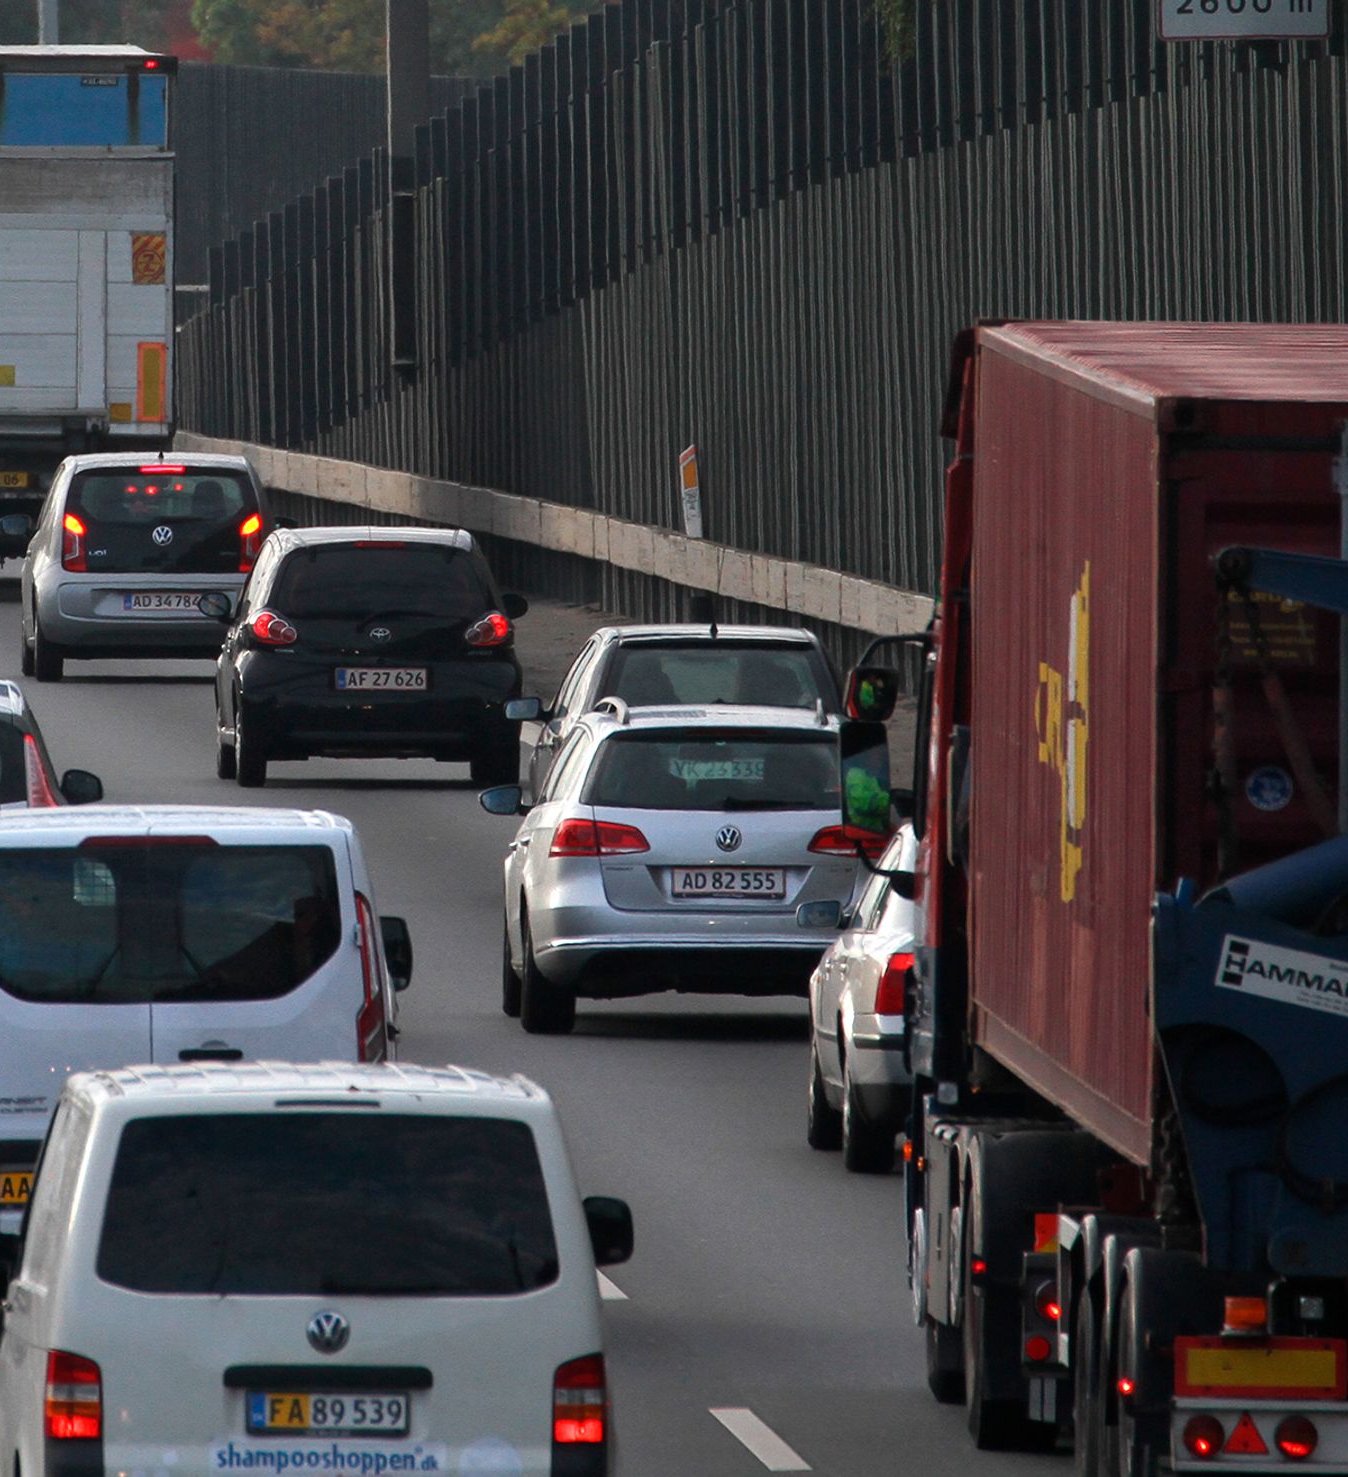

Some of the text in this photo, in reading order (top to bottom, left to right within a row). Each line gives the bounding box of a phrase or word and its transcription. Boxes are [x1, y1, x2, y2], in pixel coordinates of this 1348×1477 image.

[4, 474, 19, 485] 06
[133, 594, 201, 607] AD 34 784
[348, 673, 424, 686] AF 27 626
[682, 873, 775, 890] AD 82 555
[1225, 954, 1348, 998] HAMMA
[0, 1177, 31, 1199] AA
[269, 1399, 402, 1424] FA 89 539
